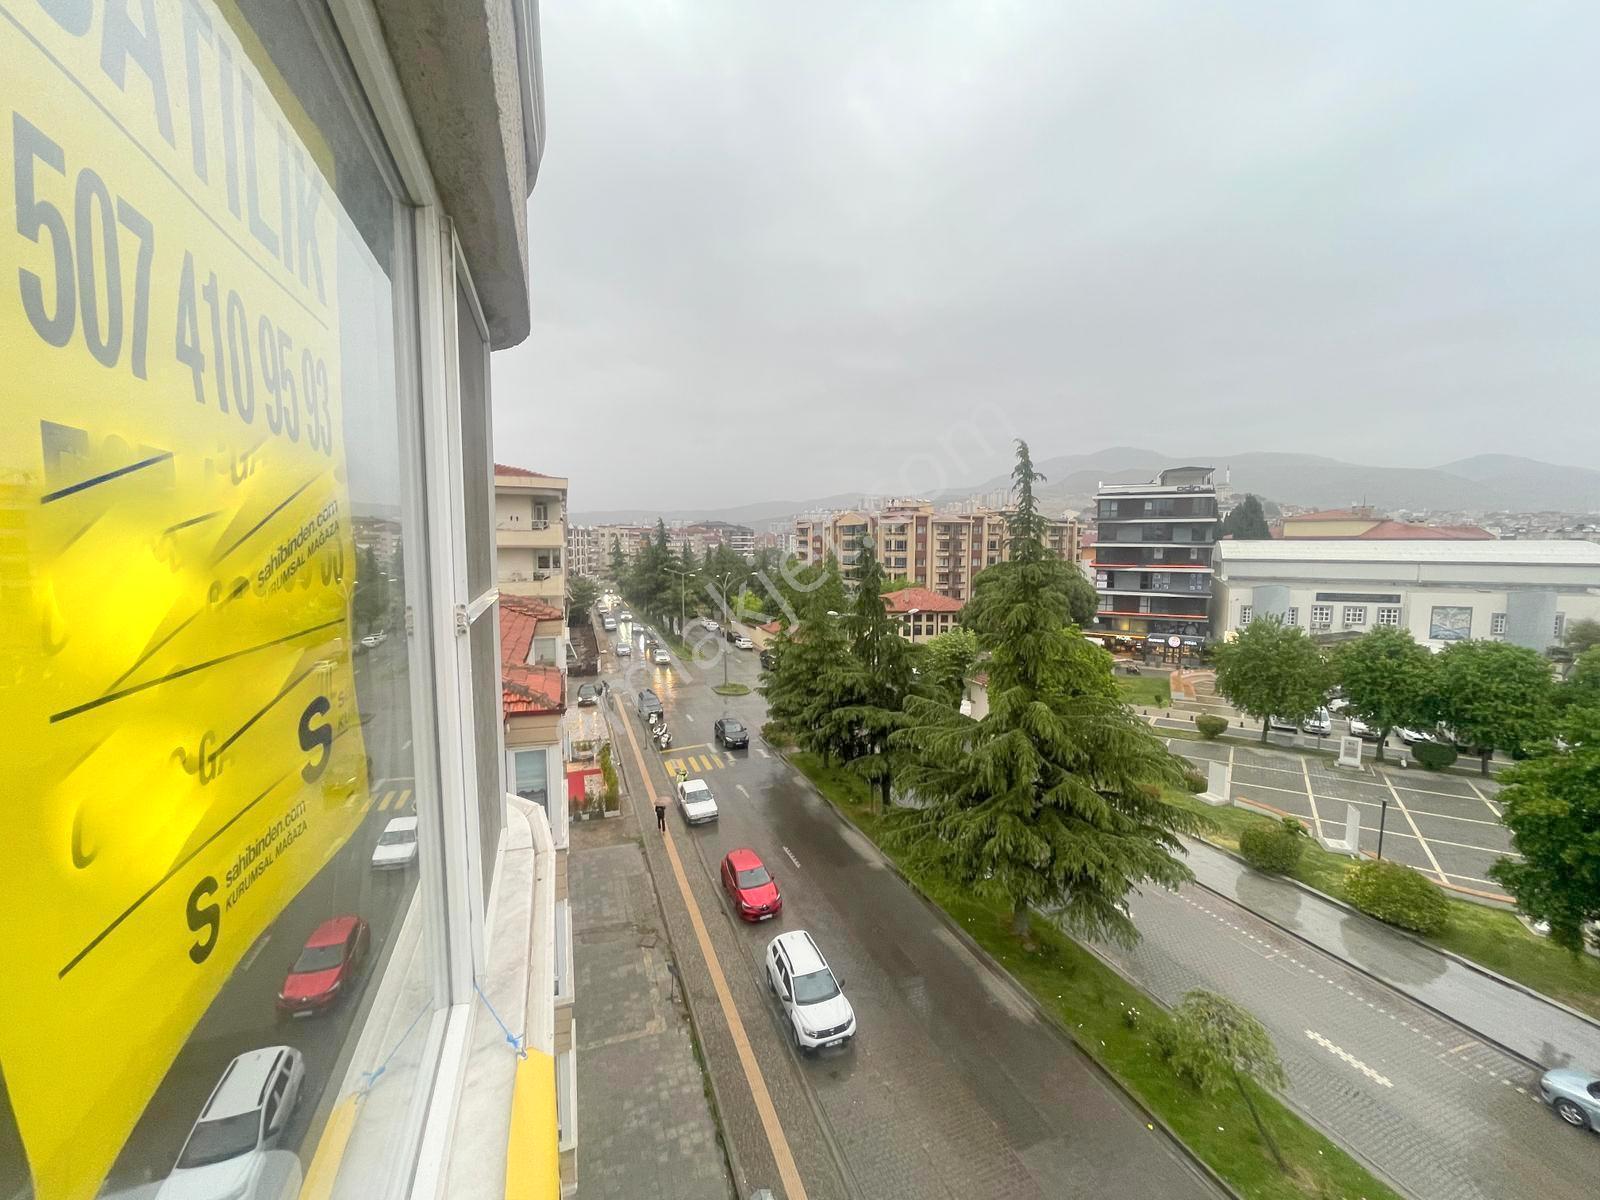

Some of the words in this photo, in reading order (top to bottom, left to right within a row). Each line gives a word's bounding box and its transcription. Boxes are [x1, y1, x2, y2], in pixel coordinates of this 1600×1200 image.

[12, 110, 154, 381] 507
[175, 249, 254, 424] 410
[258, 314, 300, 443] 95
[301, 348, 332, 456] 93
[257, 501, 338, 588] sahibinden.com
[307, 520, 339, 559] MAĞAZA
[225, 800, 306, 888] sahibinden.com
[225, 854, 274, 912] KURUMSAL
[275, 820, 308, 859] MAĞAZA
